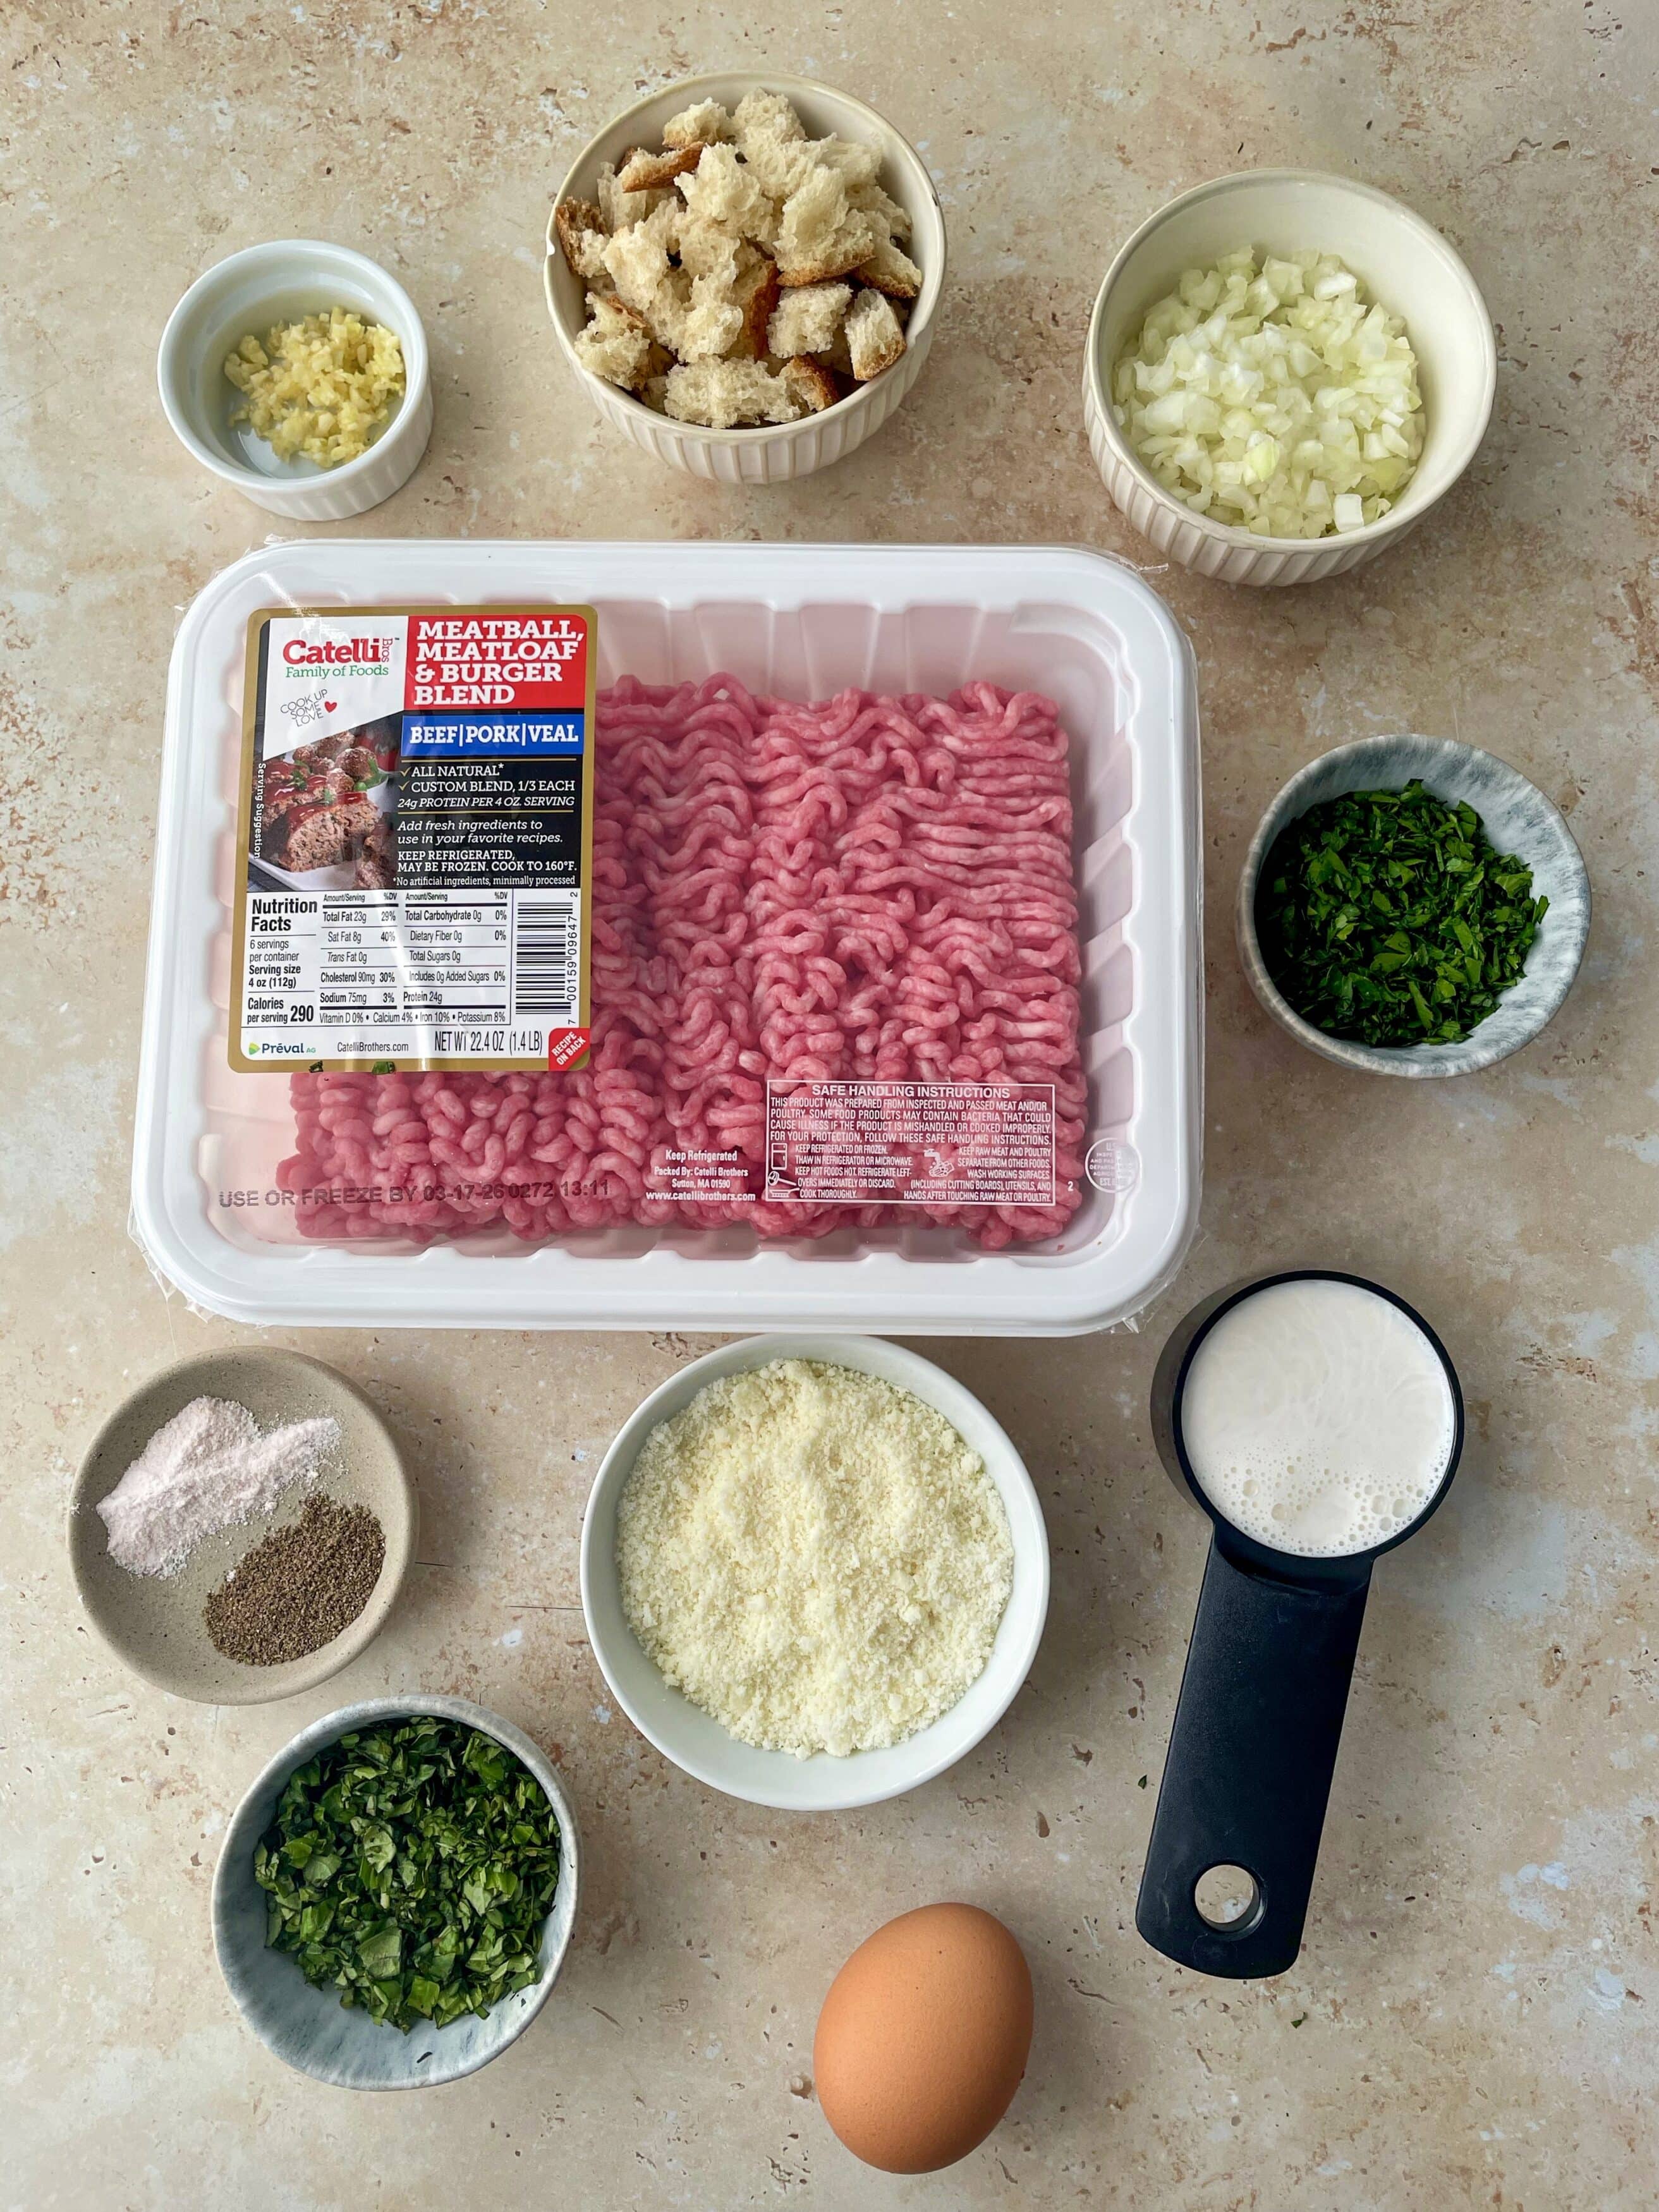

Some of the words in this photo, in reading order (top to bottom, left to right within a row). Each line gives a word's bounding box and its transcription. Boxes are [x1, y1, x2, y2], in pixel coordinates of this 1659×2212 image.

[417, 621, 584, 641] MEATBALL,
[283, 638, 380, 664] Catelli
[382, 638, 392, 662] Bros
[416, 641, 579, 661] MEATLOAF
[286, 666, 329, 679] Family
[332, 666, 346, 676] of
[349, 665, 389, 676] Foods
[415, 664, 435, 683] &
[440, 662, 562, 683] BURGER
[314, 689, 327, 700] UP
[414, 685, 514, 705] BLEND
[291, 701, 320, 719] SOME
[296, 710, 324, 727] LOVE
[411, 766, 435, 777] ALL
[255, 763, 266, 801] Serving
[411, 782, 466, 793] CUSTOM
[471, 781, 515, 793] BLEND,
[518, 781, 536, 791] 1/3
[538, 781, 575, 791] EACH
[398, 799, 417, 809] 24g
[418, 798, 470, 808] PROTEIN
[471, 798, 494, 806] PER
[495, 798, 502, 806] 4
[504, 798, 521, 806] OZ.
[524, 797, 575, 806] SERVING
[253, 803, 264, 860] Suggestion
[398, 822, 422, 831] Add
[425, 822, 455, 830] fresh
[459, 820, 527, 832] ingredients
[531, 820, 542, 829] to
[398, 836, 418, 844] use
[422, 836, 433, 844] in
[435, 836, 465, 846] your
[468, 834, 513, 843] favorite
[517, 833, 562, 844] recipes.
[398, 852, 425, 861] KEEP
[428, 851, 515, 861] REFRIGERATED,
[398, 862, 422, 872] MAY
[425, 862, 439, 872] BE
[441, 862, 489, 871] FROZEN.
[492, 862, 525, 871] COOK
[527, 861, 542, 871] TO
[444, 877, 491, 887] ingredients,
[493, 876, 533, 886] minimally
[536, 876, 575, 886] processed
[324, 894, 365, 902] Amount/Serving
[252, 899, 317, 914] Nutrition
[324, 912, 339, 921] Total
[341, 911, 353, 921] Fat
[354, 911, 367, 923] 23g
[381, 911, 396, 921] 29%
[406, 911, 422, 920] Total
[424, 910, 471, 921] Carbohydrate
[473, 910, 482, 921] 0g
[495, 910, 506, 920] 0%
[252, 916, 291, 932] Facts
[328, 933, 339, 942] Sat
[341, 932, 352, 942] Fat
[353, 932, 362, 944] 8g
[380, 932, 395, 942] 40%
[411, 931, 434, 942] Dietary
[435, 930, 453, 940] Fiber
[454, 930, 461, 942] 0g
[495, 931, 506, 940] 0%
[250, 940, 255, 949] 6
[257, 940, 289, 951] servings
[250, 954, 262, 963] per
[264, 952, 300, 961] container
[249, 965, 281, 976] Serving
[284, 965, 301, 973] size
[249, 978, 253, 987] 4
[269, 977, 296, 988] (112g)
[320, 973, 357, 983] Cholesterol
[358, 973, 375, 984] 90mg
[380, 973, 395, 982] 30%
[248, 998, 284, 1009] Calories
[320, 993, 346, 1003] Sodium
[348, 993, 367, 1005] 75mg
[383, 993, 394, 1002] 3%
[404, 992, 427, 1002] Protein
[429, 992, 442, 1004] 24g
[247, 1014, 260, 1025] per
[262, 1013, 288, 1024] serving
[290, 1006, 314, 1022] 290
[262, 1043, 304, 1054] Préval
[337, 1042, 409, 1053] CatelliBrothers.com
[435, 1031, 453, 1051] NET
[470, 1031, 489, 1051] 22.4
[493, 1031, 504, 1051] OZ
[509, 1031, 526, 1055] (1.4
[528, 1031, 542, 1055] LB)
[551, 1031, 577, 1057] RECIPE
[556, 1053, 569, 1066] ON
[565, 1037, 586, 1056] BACK
[812, 1085, 846, 1095] SAFE
[849, 1086, 914, 1097] HANDLING
[918, 1087, 1010, 1098] INSTRUCTIONS
[771, 1097, 787, 1107] THIS
[789, 1098, 823, 1107] PRODUCT
[825, 1098, 842, 1107] WAS
[844, 1098, 881, 1108] PREPARED
[884, 1099, 904, 1109] FROM
[906, 1100, 945, 1109] INSPECTED
[948, 1100, 964, 1109] AND
[966, 1100, 994, 1110] PASSED
[996, 1101, 1016, 1110] MEAT
[1018, 1101, 1047, 1111] AND/OR
[771, 1109, 806, 1118] POULTRY.
[810, 1109, 832, 1119] SOME
[835, 1110, 856, 1119] FOOD
[859, 1110, 900, 1119] PRODUCTS
[903, 1112, 921, 1120] MAY
[923, 1112, 958, 1121] CONTAIN
[961, 1112, 1000, 1121] BACTERIA
[1003, 1112, 1022, 1122] THAT
[1025, 1113, 1051, 1122] COULD
[665, 1150, 686, 1162] Keep
[688, 1150, 737, 1162] Refrigerated
[654, 1167, 679, 1176] Packed
[681, 1167, 693, 1177] By:
[694, 1167, 717, 1176] Catelli
[718, 1168, 748, 1176] Brothers
[672, 1179, 696, 1189] Sutton,
[698, 1179, 710, 1188] MA
[1067, 1181, 1073, 1191] 2
[219, 1191, 259, 1208] USE
[265, 1190, 295, 1206] OR
[301, 1187, 382, 1205] FREEZE
[389, 1186, 417, 1202] BY
[423, 1184, 504, 1201] 03-17-26
[508, 1182, 554, 1198] 0272
[561, 1179, 608, 1196] 13:11
[646, 1191, 755, 1201] www.catellibrothers.com
